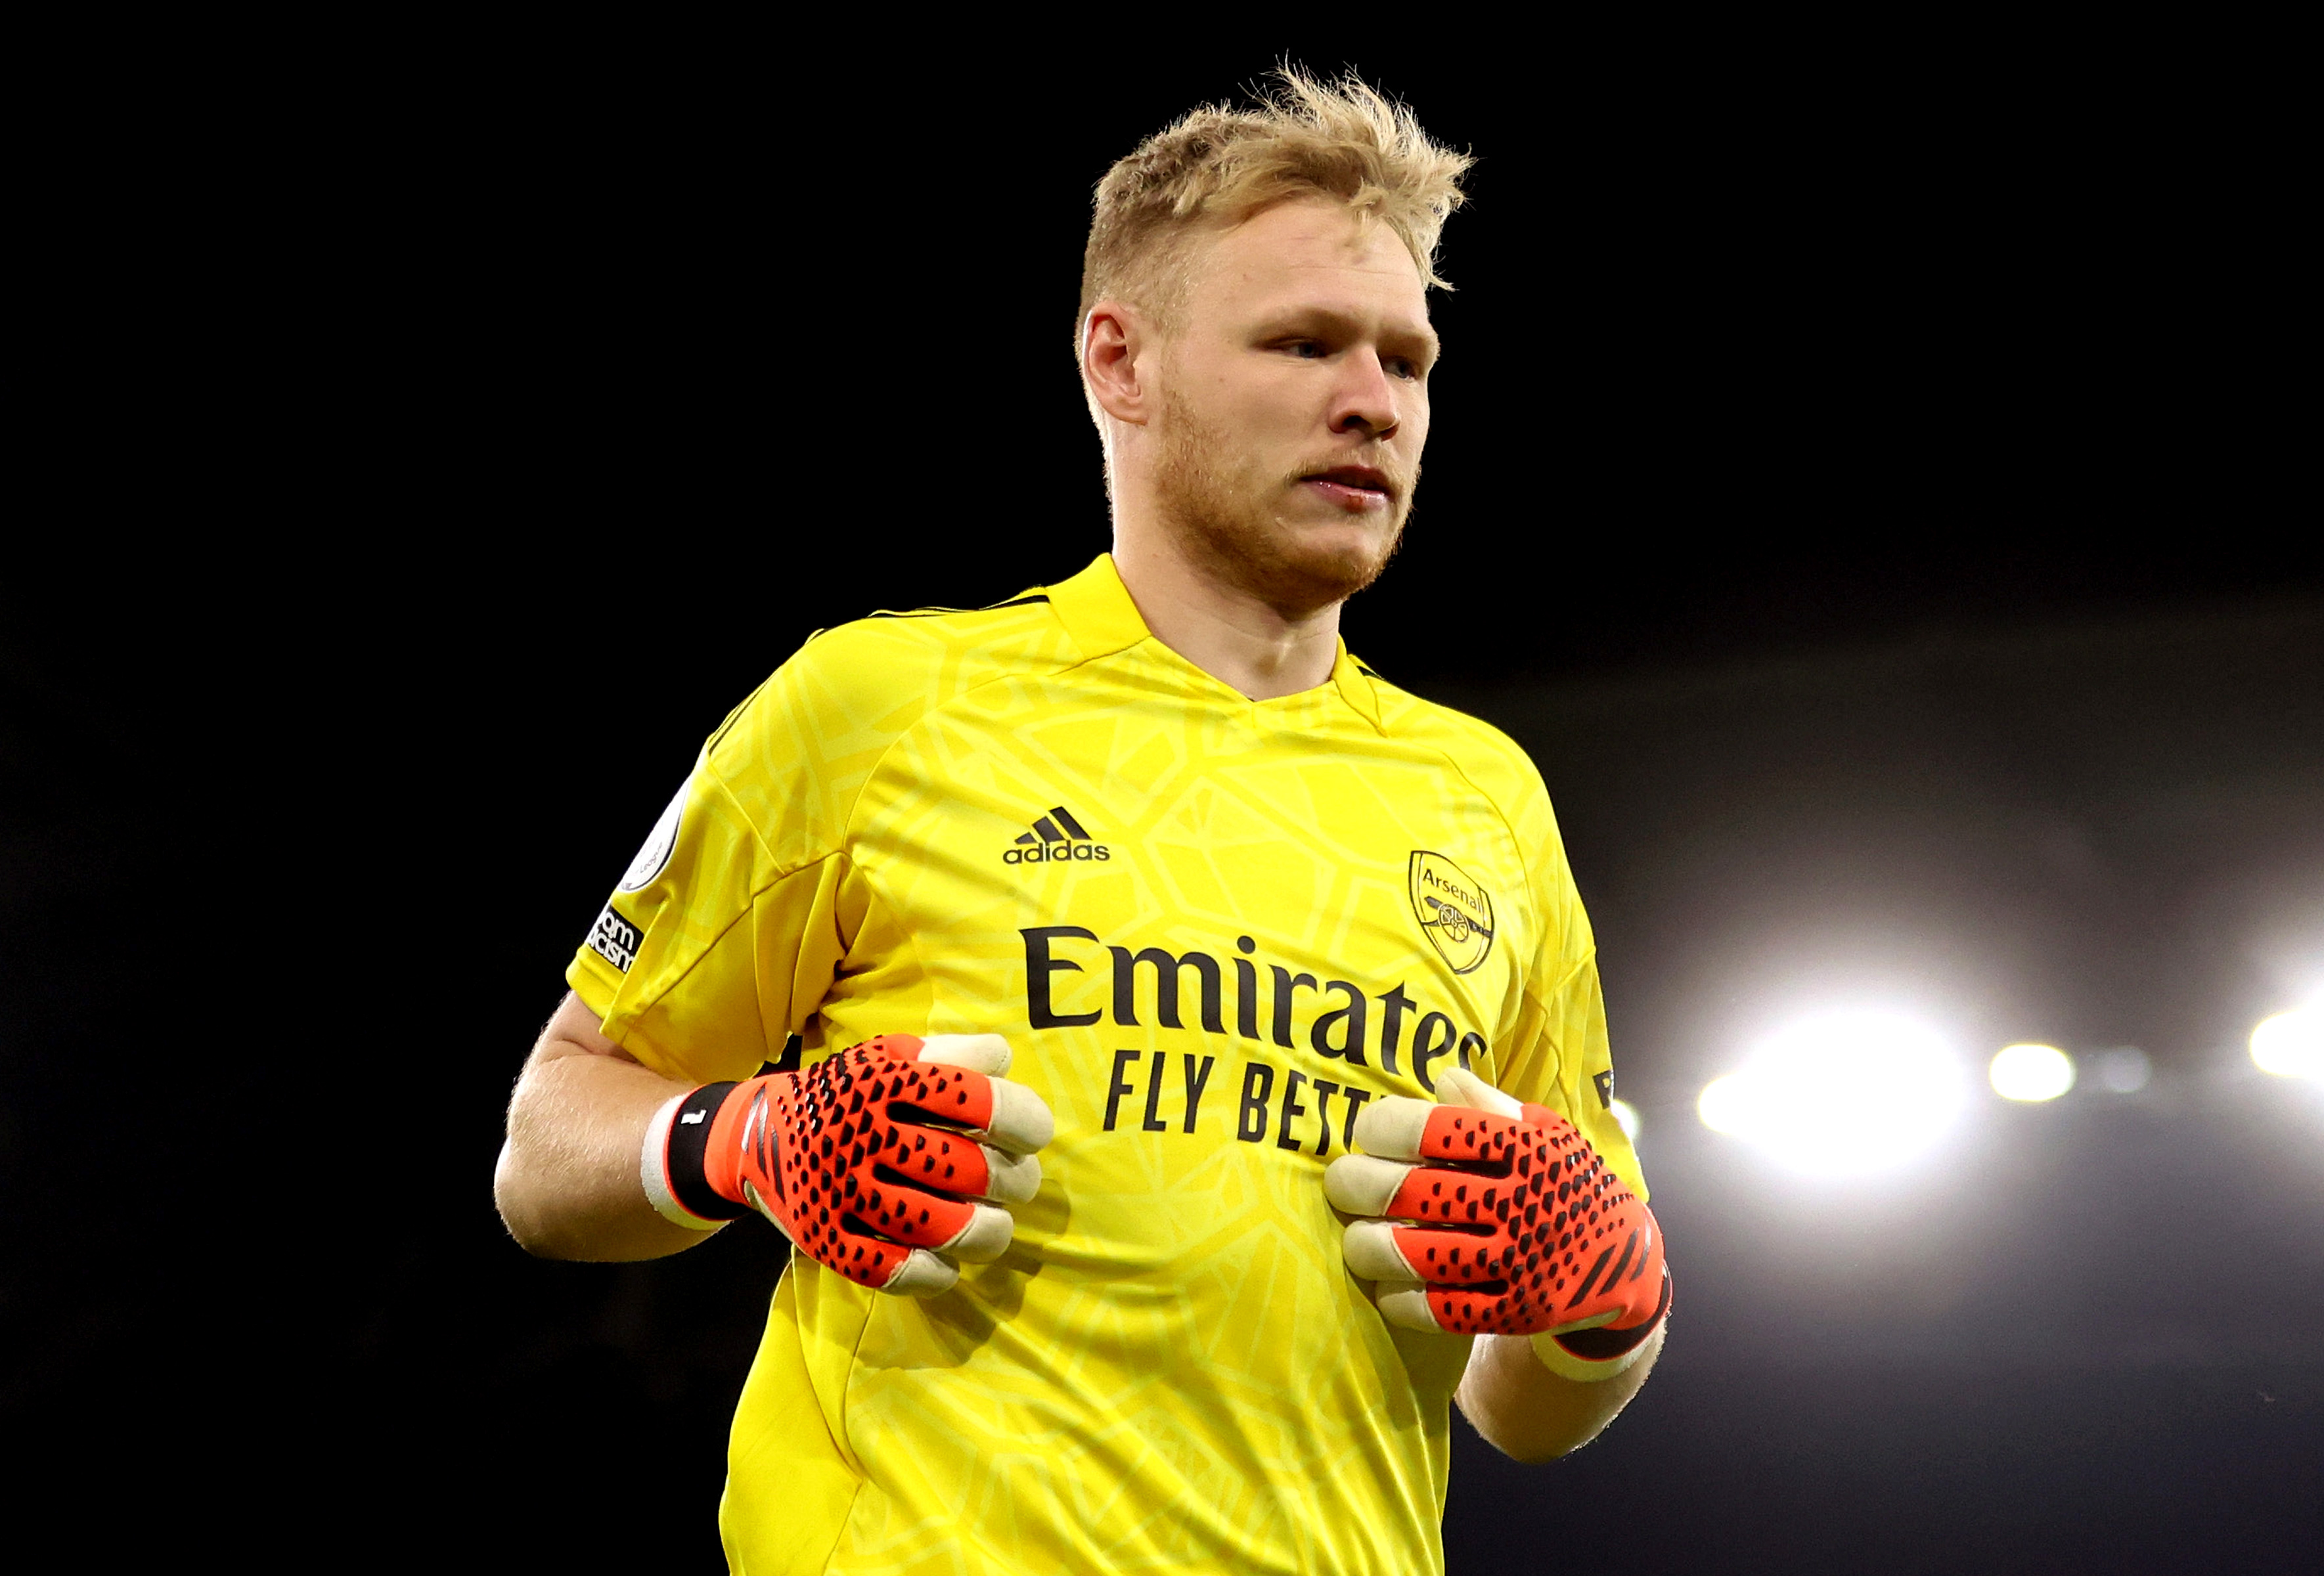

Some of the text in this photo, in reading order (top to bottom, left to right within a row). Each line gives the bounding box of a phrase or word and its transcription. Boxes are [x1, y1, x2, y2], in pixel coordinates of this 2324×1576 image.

[1002, 839, 1111, 865] adidas
[1423, 868, 1482, 913] Arsenal
[1104, 1049, 1387, 1158] FLY BETT
